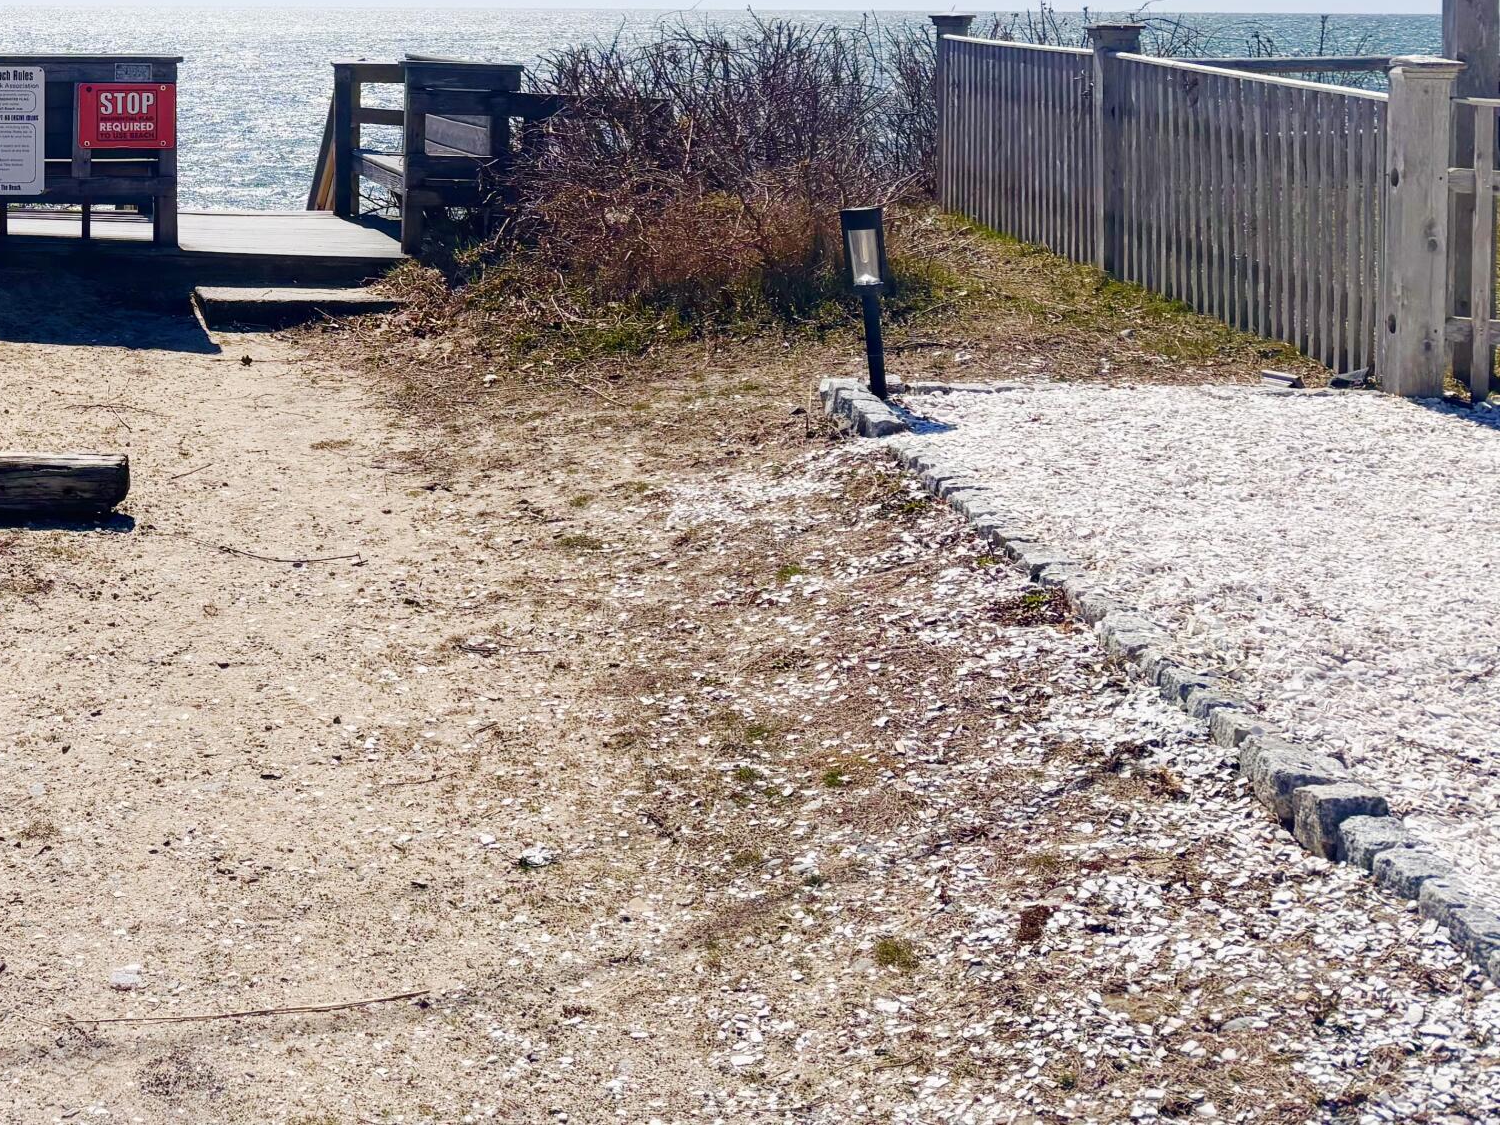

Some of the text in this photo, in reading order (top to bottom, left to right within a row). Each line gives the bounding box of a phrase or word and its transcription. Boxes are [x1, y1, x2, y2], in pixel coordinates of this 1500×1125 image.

[13, 69, 34, 81] Rules
[100, 92, 154, 114] STOP
[100, 122, 154, 132] REQUIRED
